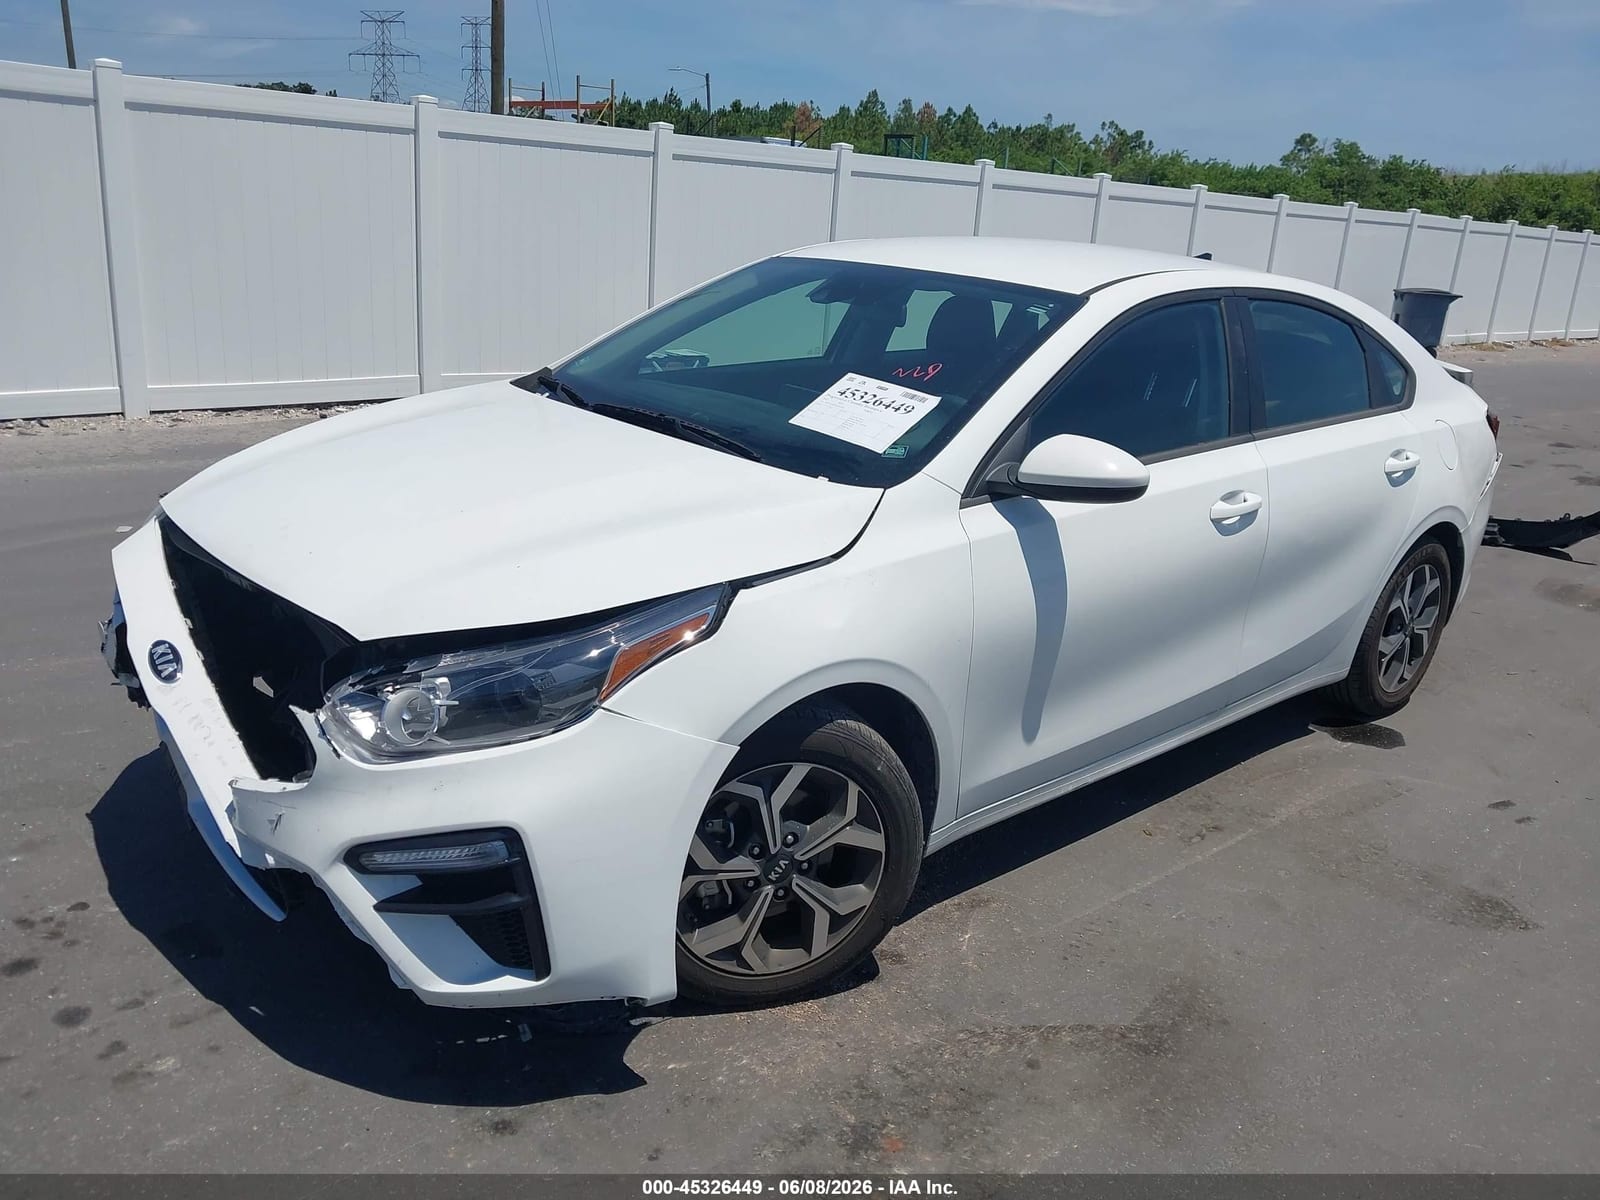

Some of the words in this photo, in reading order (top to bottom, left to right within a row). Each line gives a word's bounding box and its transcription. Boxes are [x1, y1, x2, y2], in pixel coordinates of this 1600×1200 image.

[837, 387, 915, 415] 45326449
[151, 643, 178, 678] KIA
[767, 859, 790, 881] KIA
